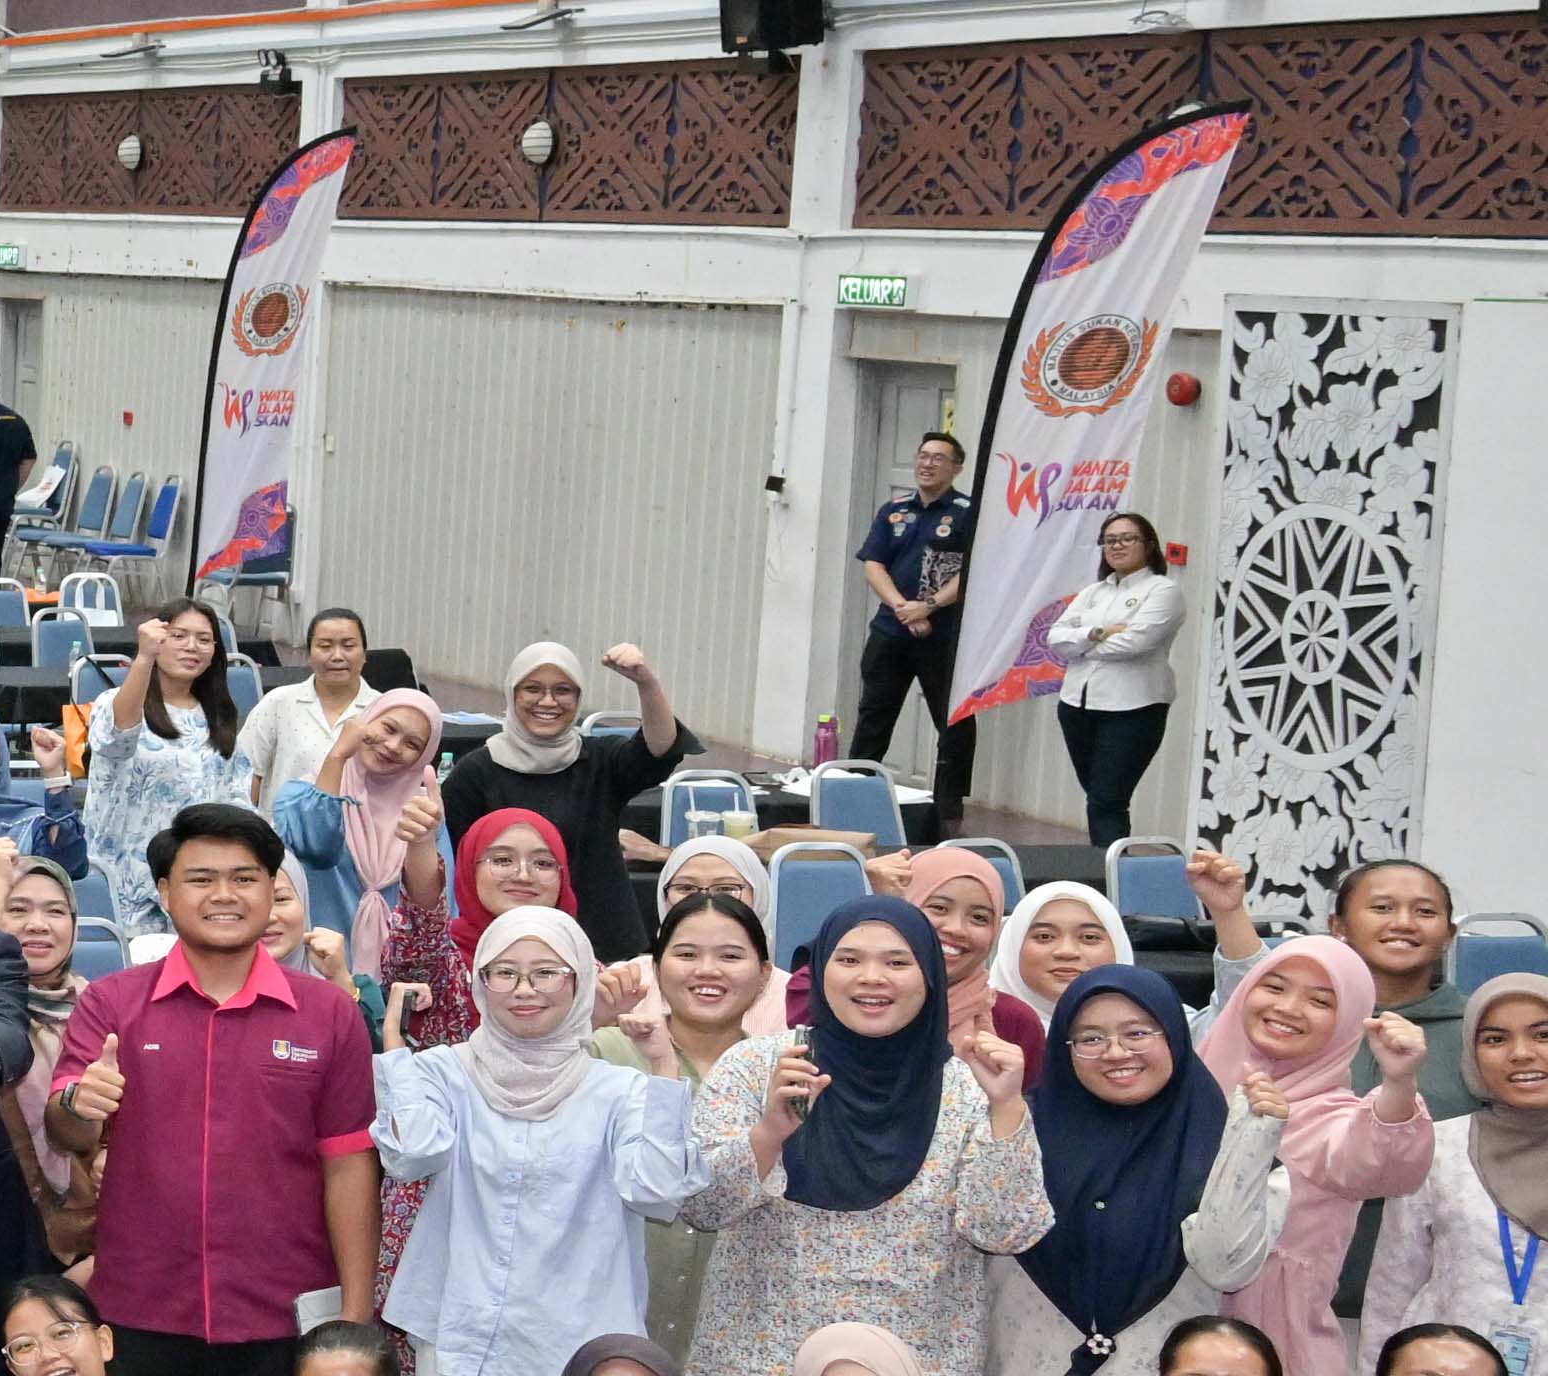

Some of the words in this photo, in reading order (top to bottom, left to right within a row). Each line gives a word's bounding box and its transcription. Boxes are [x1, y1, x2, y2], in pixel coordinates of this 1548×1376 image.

[840, 277, 892, 304] KELUAR
[1048, 331, 1076, 372] MAJLIS
[1078, 318, 1122, 331] SUKAN
[1059, 384, 1115, 400] MALAYSIA
